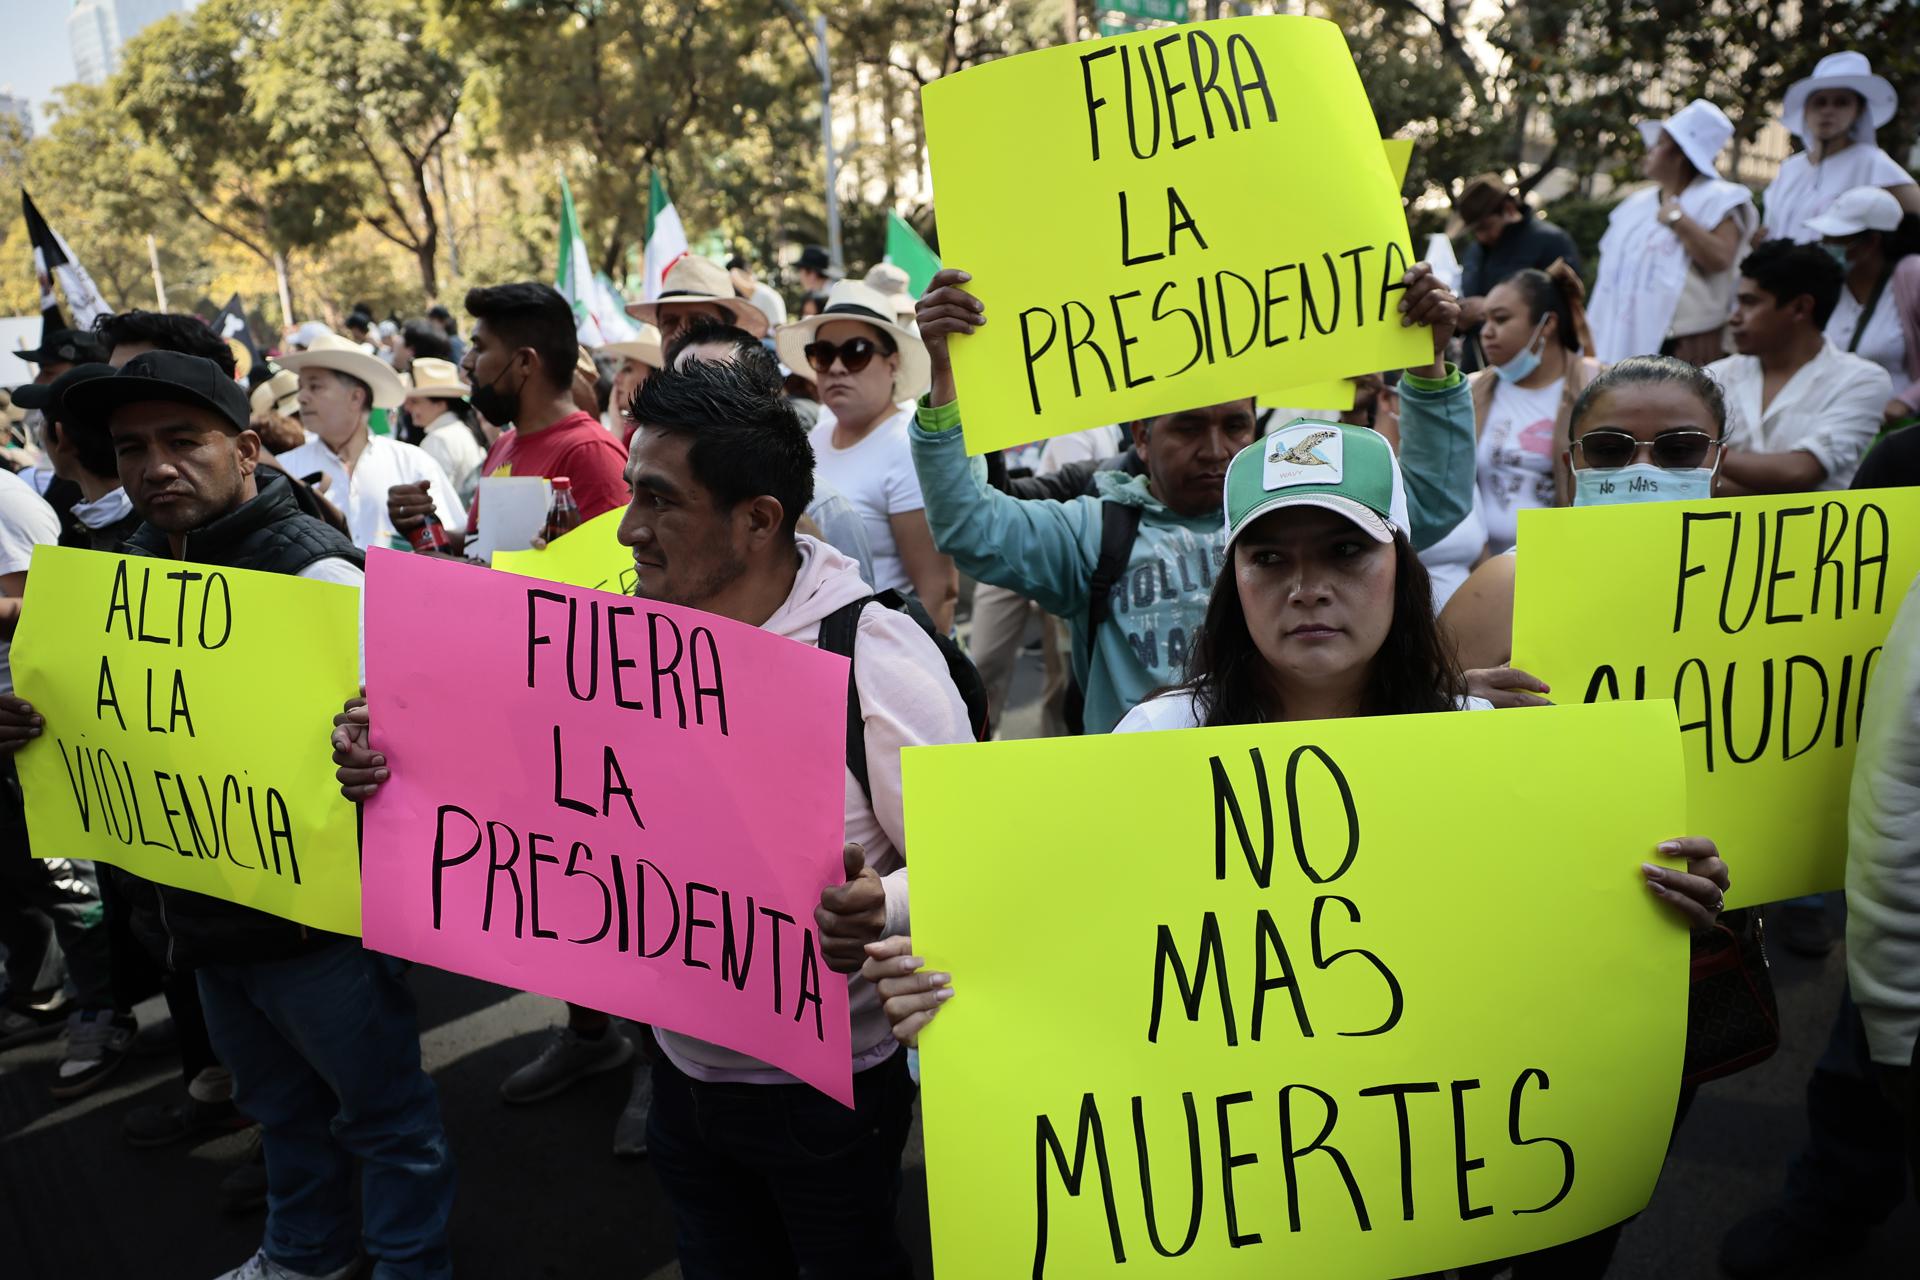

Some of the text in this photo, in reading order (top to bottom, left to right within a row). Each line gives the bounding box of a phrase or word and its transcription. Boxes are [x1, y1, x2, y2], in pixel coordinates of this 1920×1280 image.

[1080, 30, 1278, 162] FUERA
[1119, 187, 1209, 267] LA
[1019, 242, 1411, 415] PRESIDENTA
[1280, 470, 1303, 479] WAVY
[1599, 475, 1659, 495] NO MAS
[105, 558, 232, 650] ALTO
[1673, 501, 1889, 635] FUERA
[97, 655, 196, 738] A LA
[526, 587, 729, 738] FUERA
[553, 725, 645, 831] LA
[1209, 745, 1360, 889] NO
[433, 803, 824, 1042] PRESIDENTA
[1148, 895, 1404, 1047] MAS
[1033, 1068, 1576, 1280] MUERTES
